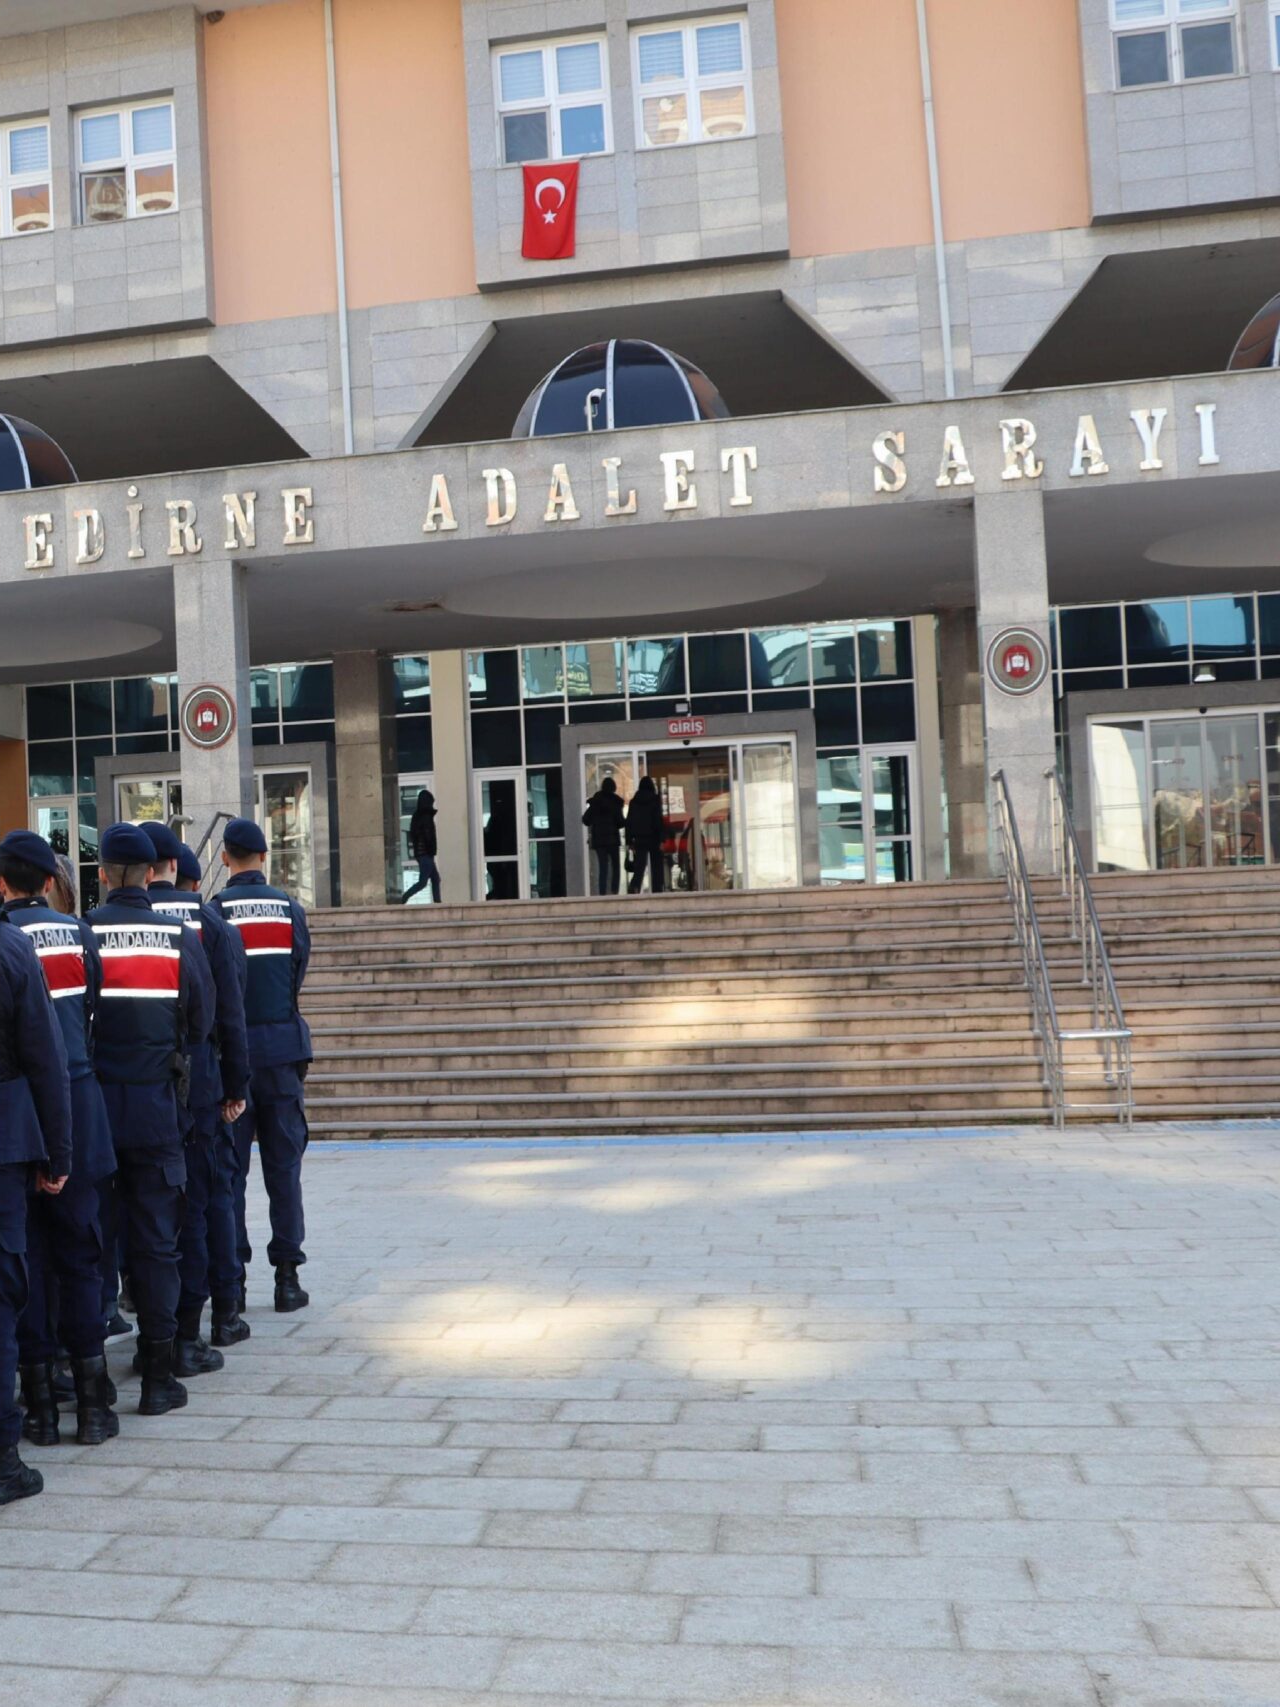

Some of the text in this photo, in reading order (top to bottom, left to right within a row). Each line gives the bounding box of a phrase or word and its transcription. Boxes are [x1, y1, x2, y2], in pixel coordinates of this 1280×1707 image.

[22, 403, 1220, 569] EDİRNE ADALET SARAYI
[668, 719, 704, 735] GİRİŞ
[229, 903, 286, 919] JANDARMA
[101, 930, 172, 950] JANDARMA
